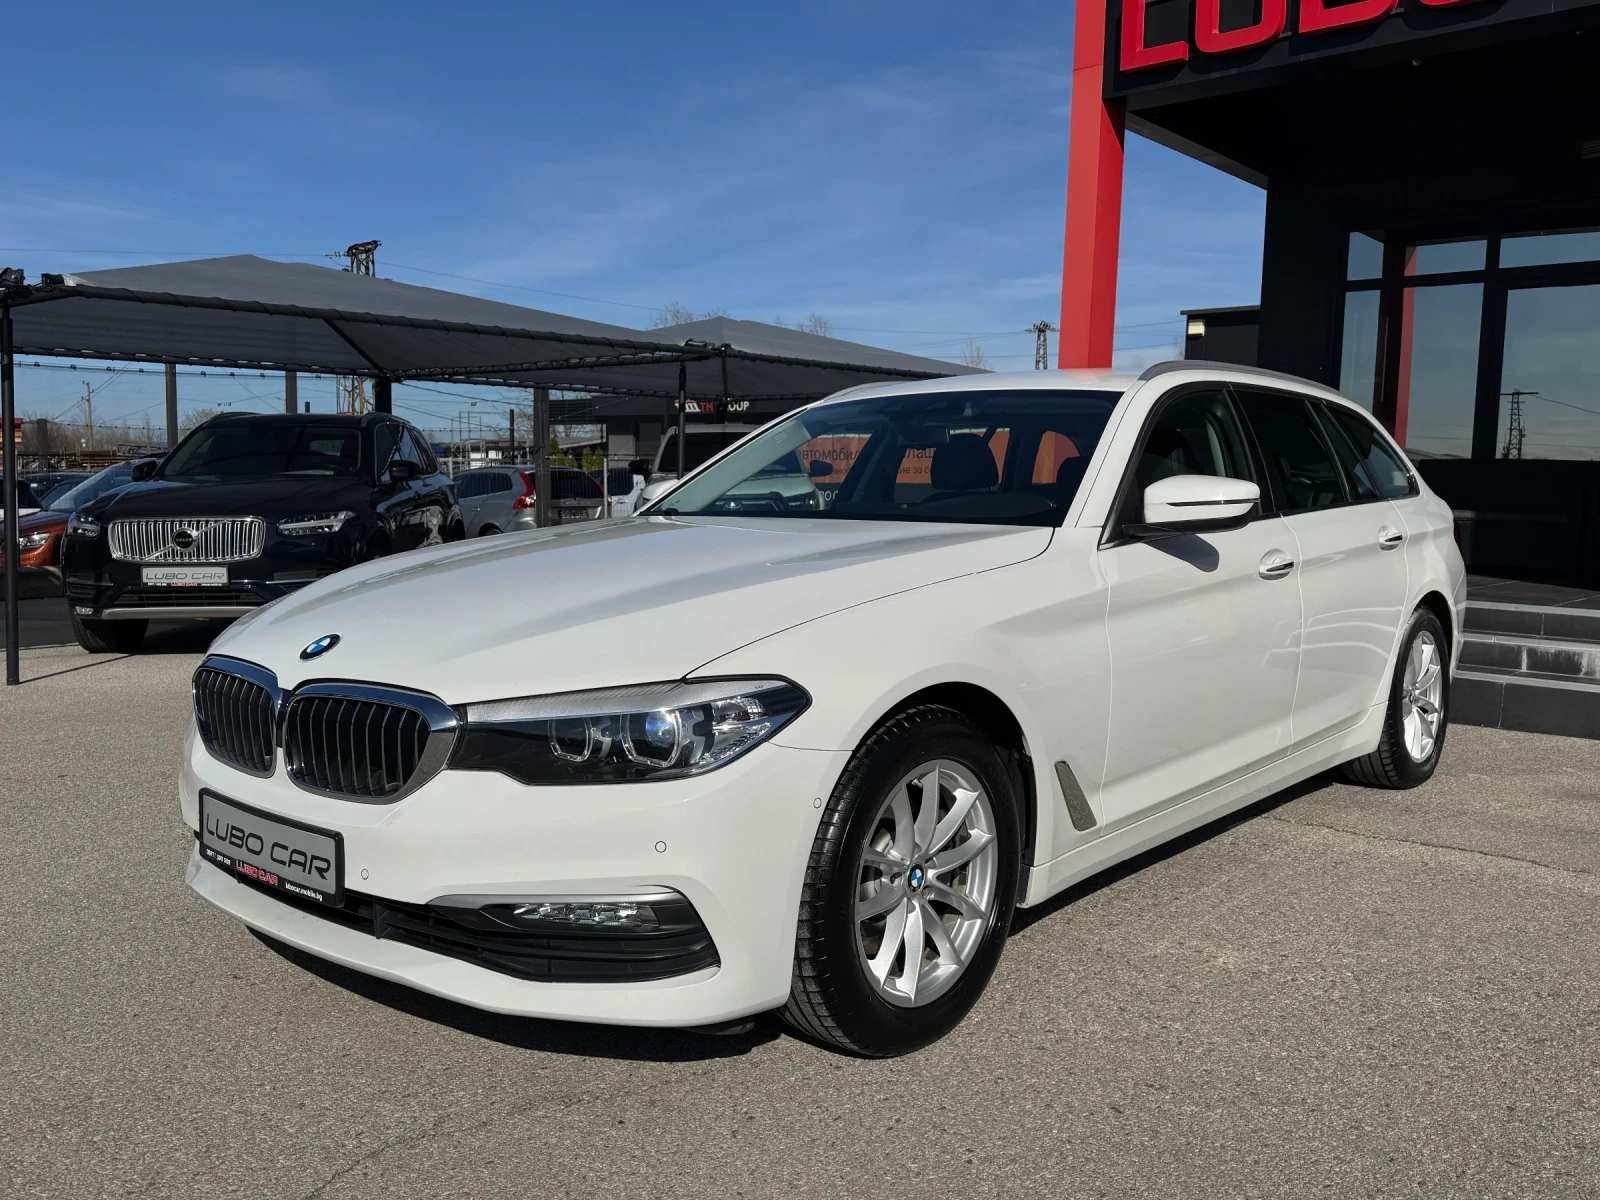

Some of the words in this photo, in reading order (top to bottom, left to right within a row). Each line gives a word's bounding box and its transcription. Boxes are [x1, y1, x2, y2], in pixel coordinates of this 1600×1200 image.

[1120, 0, 1482, 71] LU
[700, 402, 714, 412] TM
[206, 814, 264, 856] LUBO
[270, 841, 332, 881] CAR
[236, 860, 258, 876] LUBO
[258, 868, 279, 886] CAR
